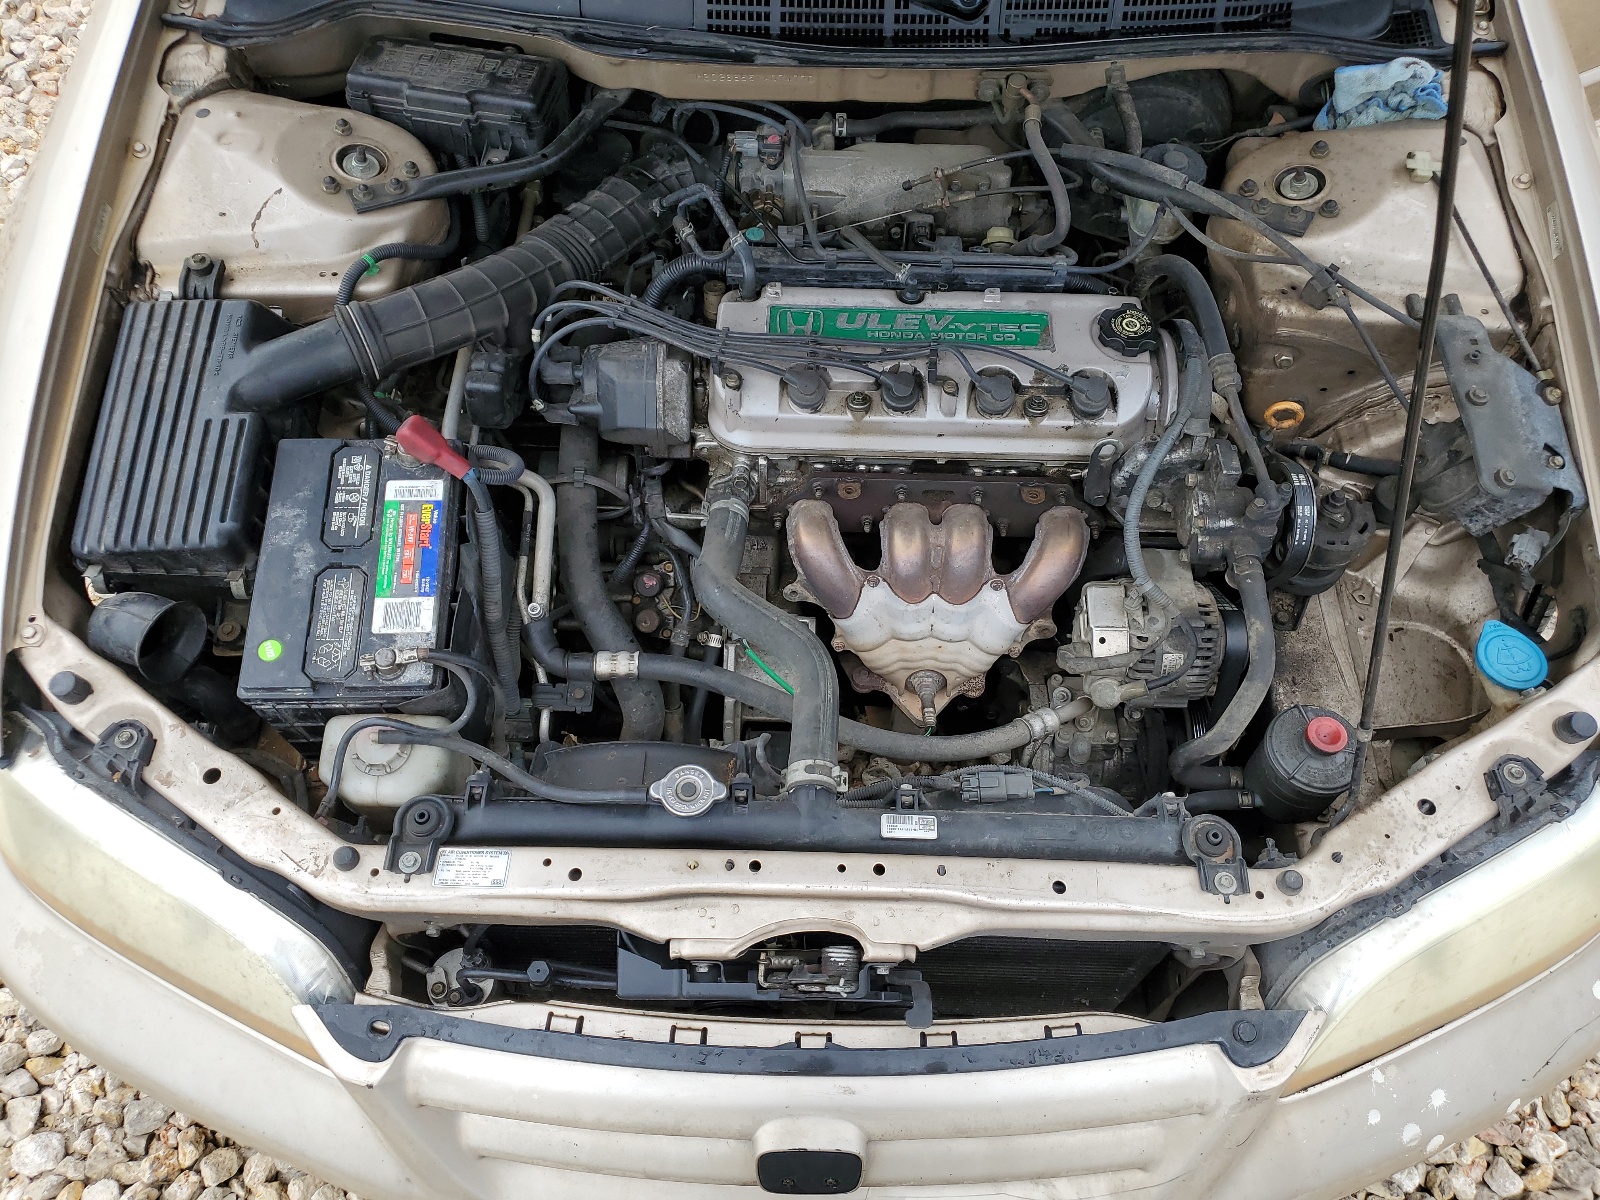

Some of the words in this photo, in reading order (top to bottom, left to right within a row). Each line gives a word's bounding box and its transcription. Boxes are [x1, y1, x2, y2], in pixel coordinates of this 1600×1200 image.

[867, 331, 925, 339] HONDA
[931, 332, 987, 341] MOTOR
[362, 470, 371, 496] DANGER
[359, 502, 367, 526] POISON
[418, 503, 434, 548] EverStart
[674, 769, 705, 779] DANGER
